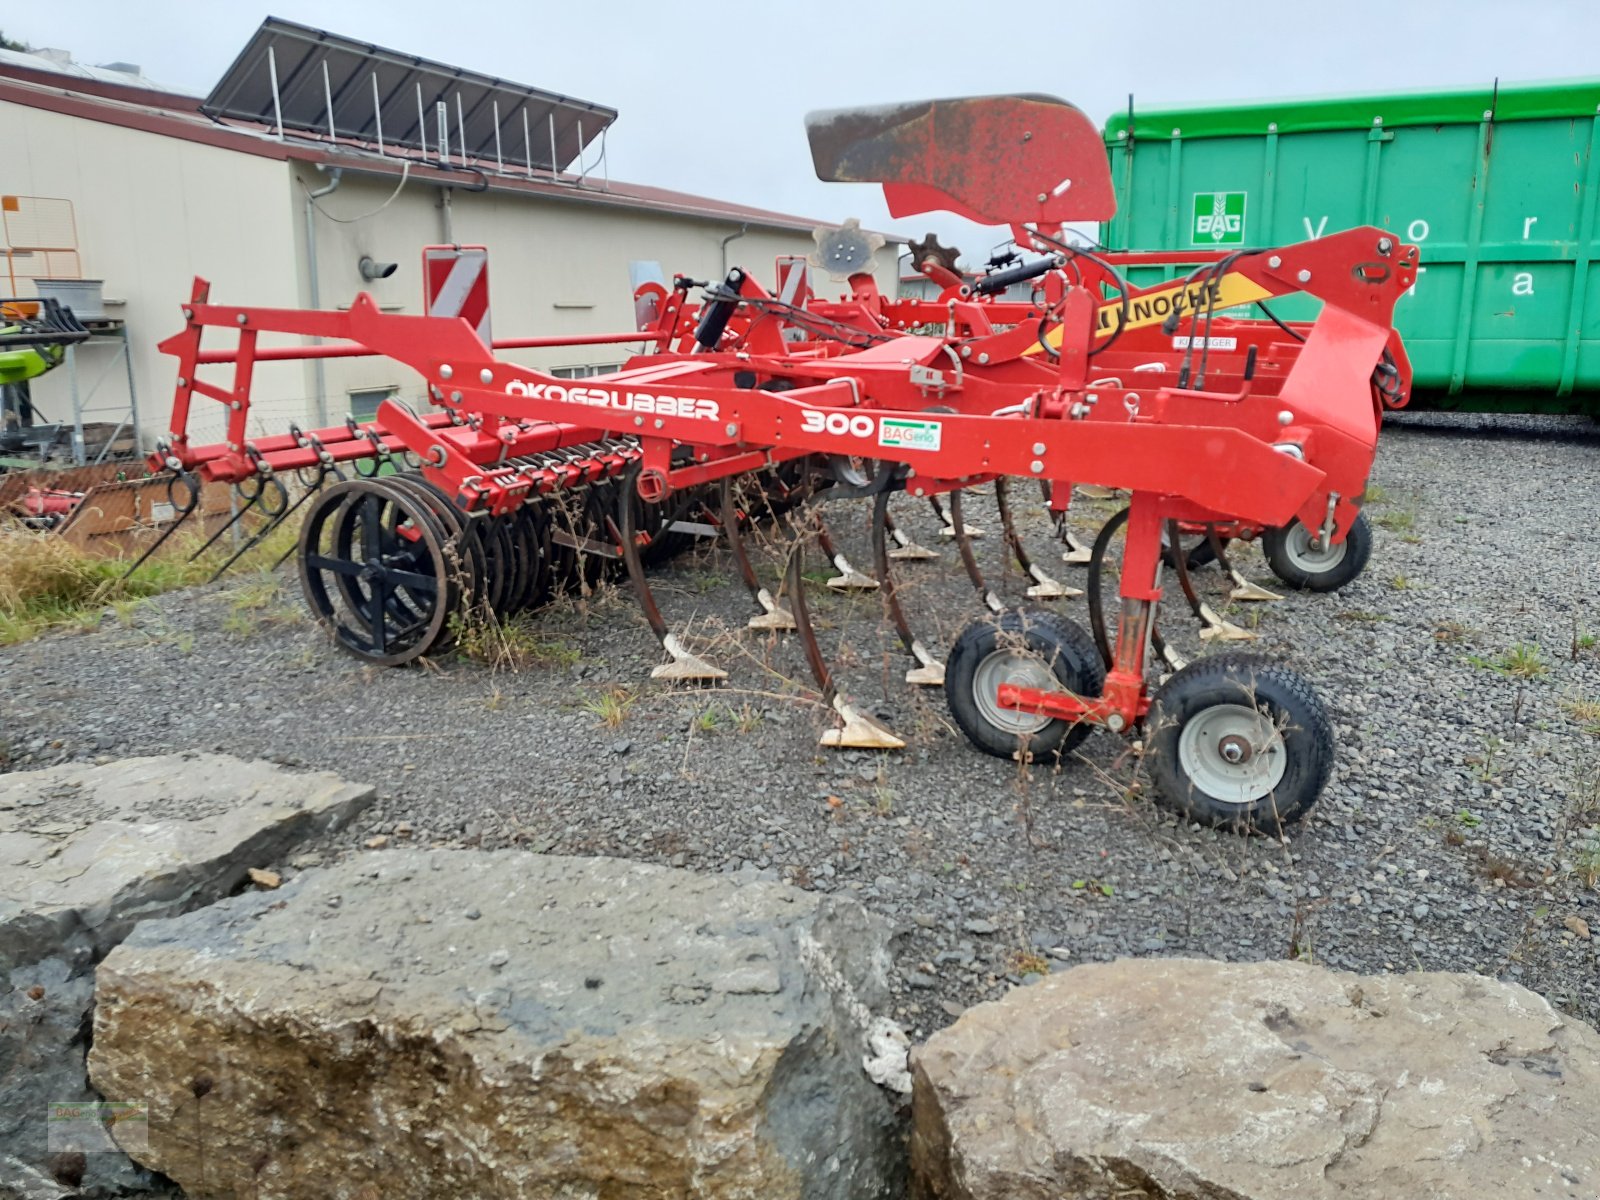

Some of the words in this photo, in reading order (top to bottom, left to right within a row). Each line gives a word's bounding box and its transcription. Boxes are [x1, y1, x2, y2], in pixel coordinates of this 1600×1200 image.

[1197, 215, 1241, 233] BAG
[1512, 271, 1535, 295] a
[1116, 280, 1223, 325] KNOCHE
[1179, 338, 1232, 347] KIZGER
[505, 379, 720, 422] ÖKOGRUBBER
[801, 409, 875, 438] 300
